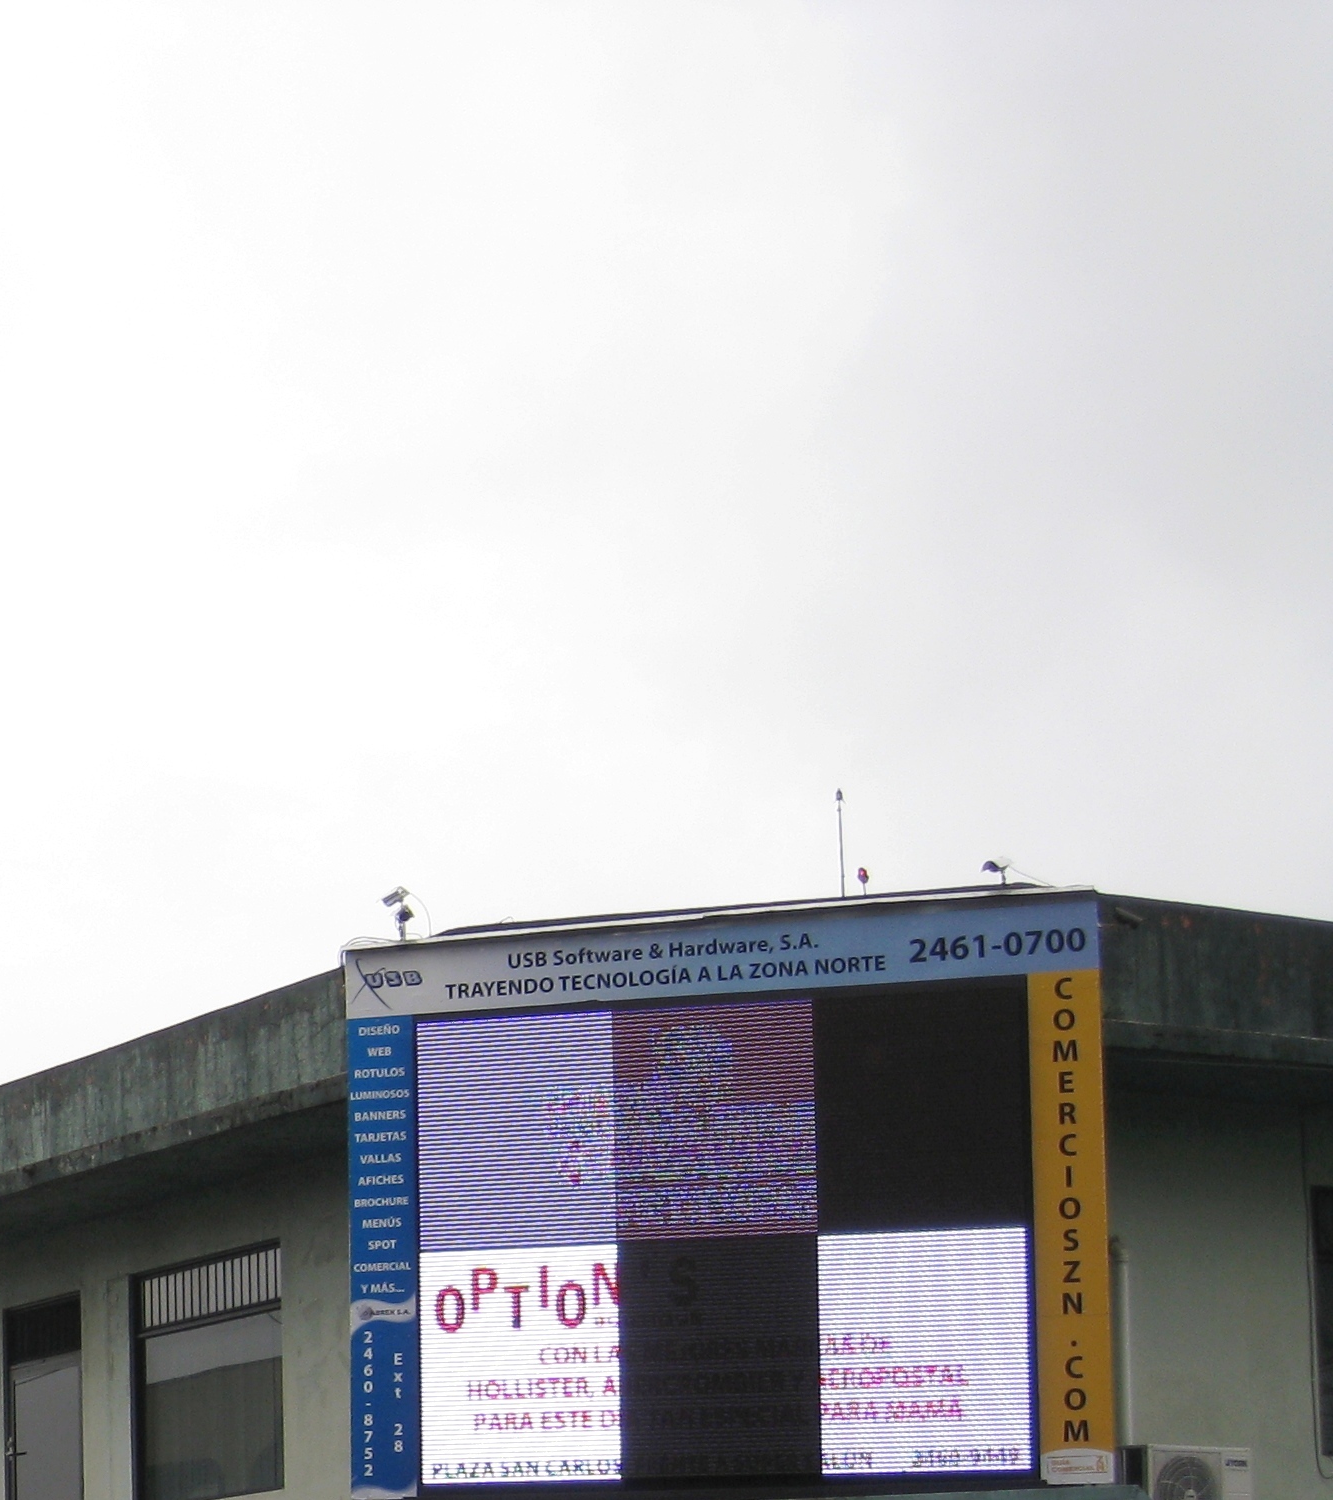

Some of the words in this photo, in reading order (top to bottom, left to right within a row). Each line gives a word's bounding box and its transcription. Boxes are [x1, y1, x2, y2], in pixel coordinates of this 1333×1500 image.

[508, 951, 547, 970] USB
[553, 947, 643, 967] Software
[649, 943, 664, 959] &
[669, 936, 774, 959] Hardware,
[779, 932, 819, 951] S.A.
[908, 928, 1087, 963] 2461-0700
[445, 977, 554, 999] TRAYENDO
[558, 965, 691, 992] TECNOLOGÍA
[698, 969, 712, 984] A
[717, 963, 742, 982] LA
[749, 958, 808, 979] ZONA
[815, 954, 886, 976] NORTE
[358, 1023, 401, 1036] DISEÑO
[367, 1046, 392, 1057] WEB
[354, 1067, 405, 1079] ROTULOS
[350, 1089, 410, 1101] LUMINOSOS
[354, 1109, 407, 1122] BANNERS
[354, 1131, 407, 1143] TARJETAS
[360, 1152, 402, 1165] VALLAS
[357, 1174, 404, 1186] AFICHES
[354, 1196, 409, 1208] BROCHURE
[362, 1216, 402, 1229] MENÚS
[368, 1239, 397, 1251] SPOT
[353, 1261, 412, 1272] COMERCIAL
[360, 1284, 369, 1294] Y
[539, 1346, 587, 1365] CON
[363, 1331, 374, 1477] 2460-8752
[474, 1413, 534, 1431] PARA
[540, 1410, 592, 1430] ESTE
[393, 1423, 404, 1453] 28
[432, 1462, 494, 1479] PLAZA
[501, 1461, 539, 1478] SAN
